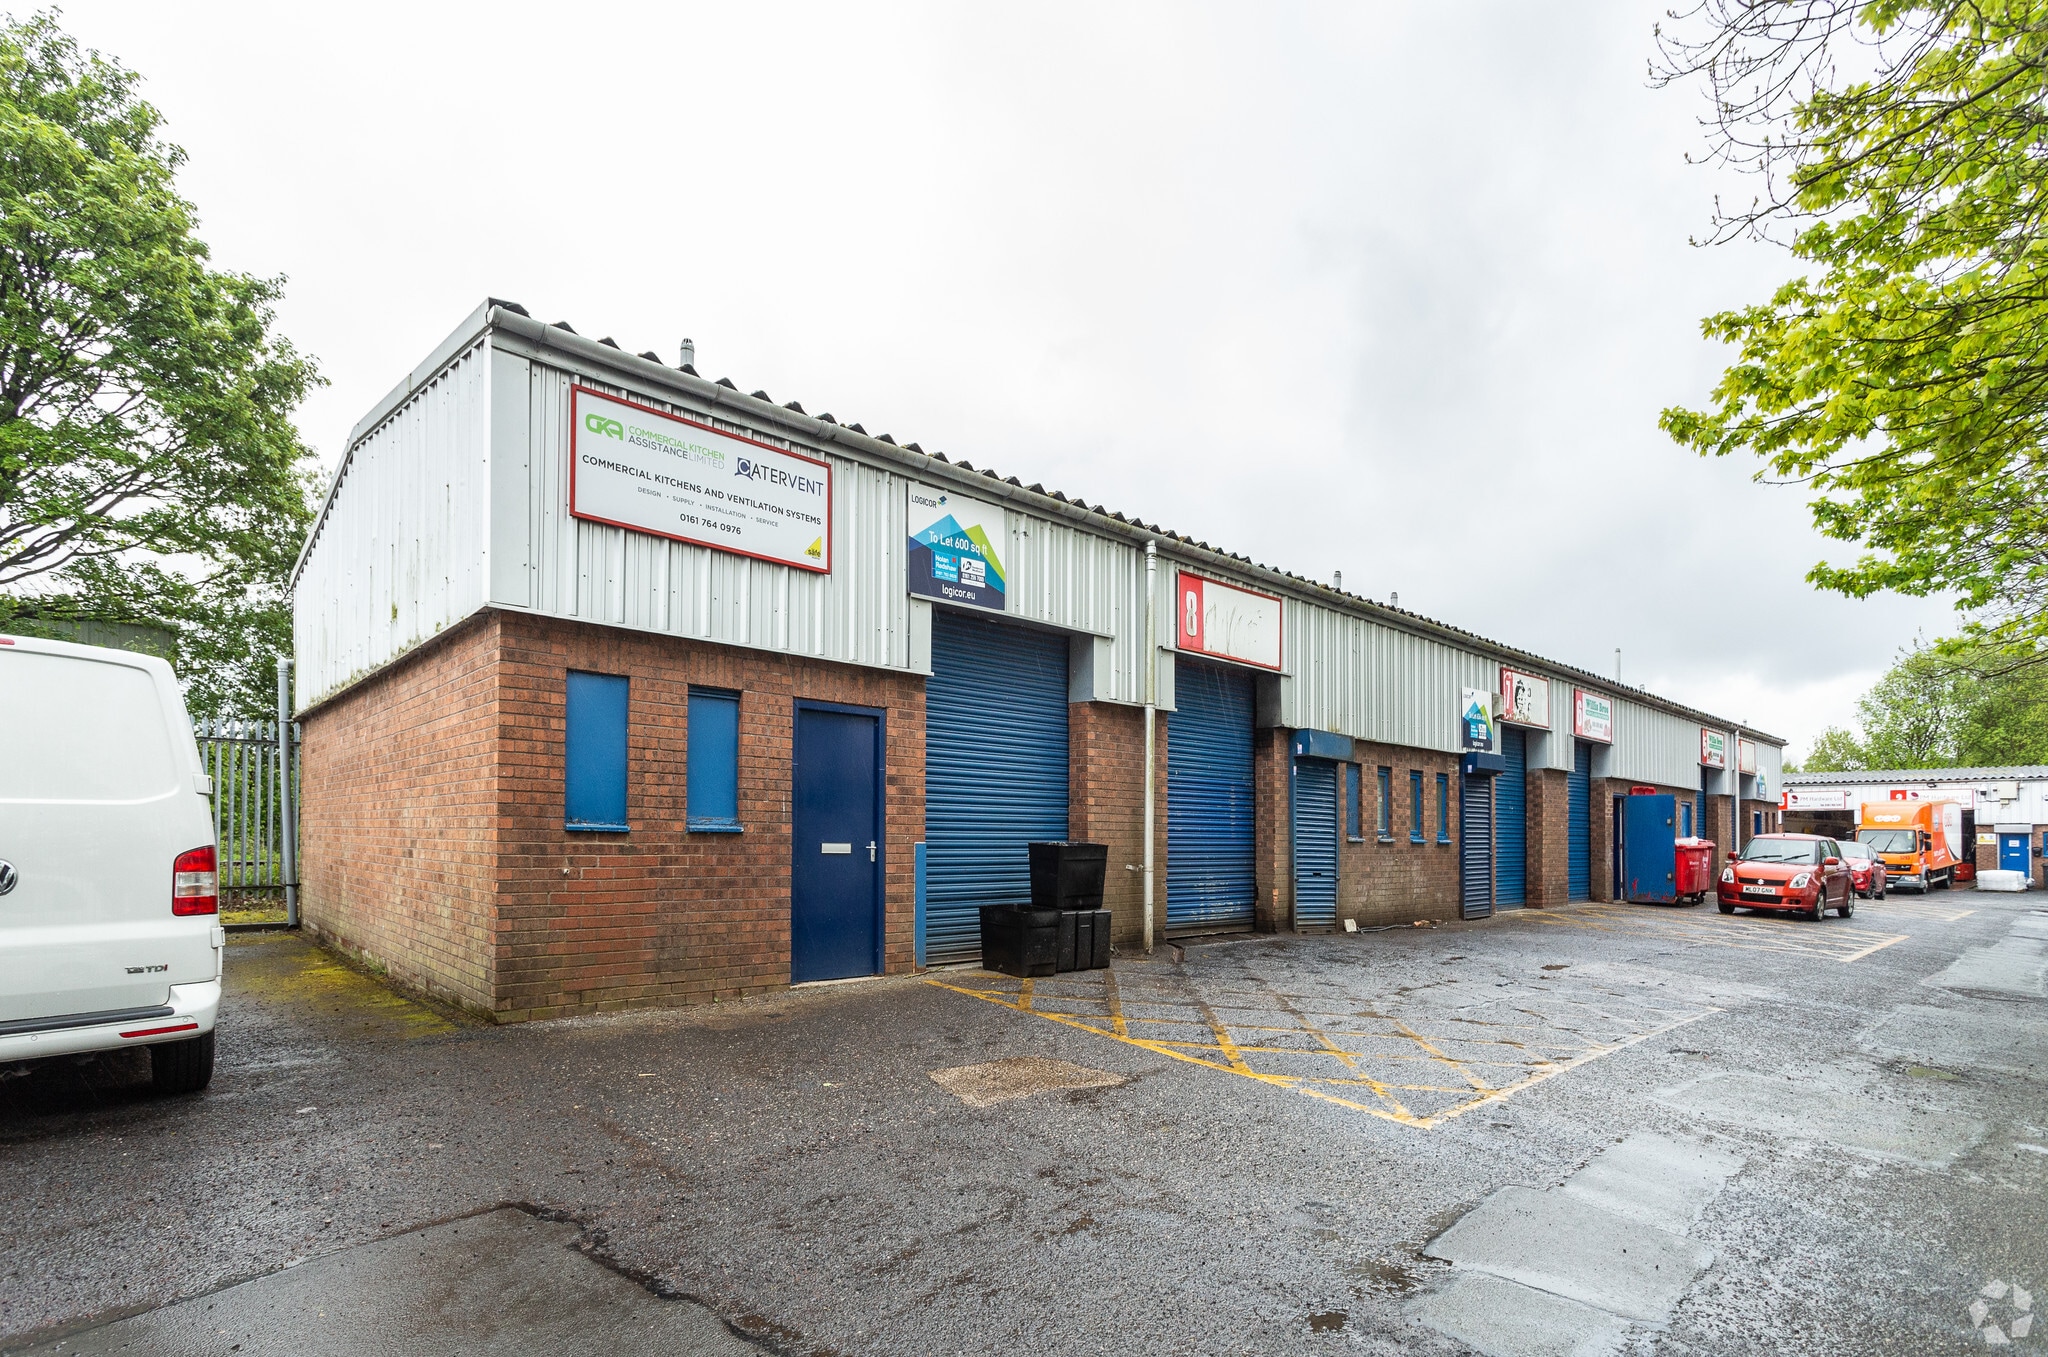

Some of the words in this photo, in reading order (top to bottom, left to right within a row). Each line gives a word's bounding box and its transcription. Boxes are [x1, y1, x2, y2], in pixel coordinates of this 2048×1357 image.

[628, 425, 688, 450] COMMERCIAL
[689, 444, 725, 461] KITCHEN
[582, 454, 652, 481] COMMERCIAL
[654, 474, 702, 494] KITCHENS
[704, 487, 724, 499] AND
[727, 493, 784, 515] VENTILATION
[786, 509, 822, 525] SYSTEMS
[738, 457, 824, 497] CATERVENT
[637, 486, 662, 498] DESIGN
[672, 495, 695, 506] SUPPLY
[705, 504, 747, 519] INSTALLATION
[755, 517, 779, 527] SERVICE
[911, 494, 937, 508] LOGICOR
[679, 513, 699, 525] 0161
[702, 518, 718, 529] 764
[720, 523, 742, 535] 0976
[929, 530, 938, 544] To
[940, 534, 953, 548] Let
[955, 537, 969, 551] 600
[970, 543, 980, 556] sq
[982, 543, 988, 555] ft
[942, 583, 976, 600] logicor.eu
[1185, 590, 1198, 637] 8
[1577, 699, 1583, 727] 6
